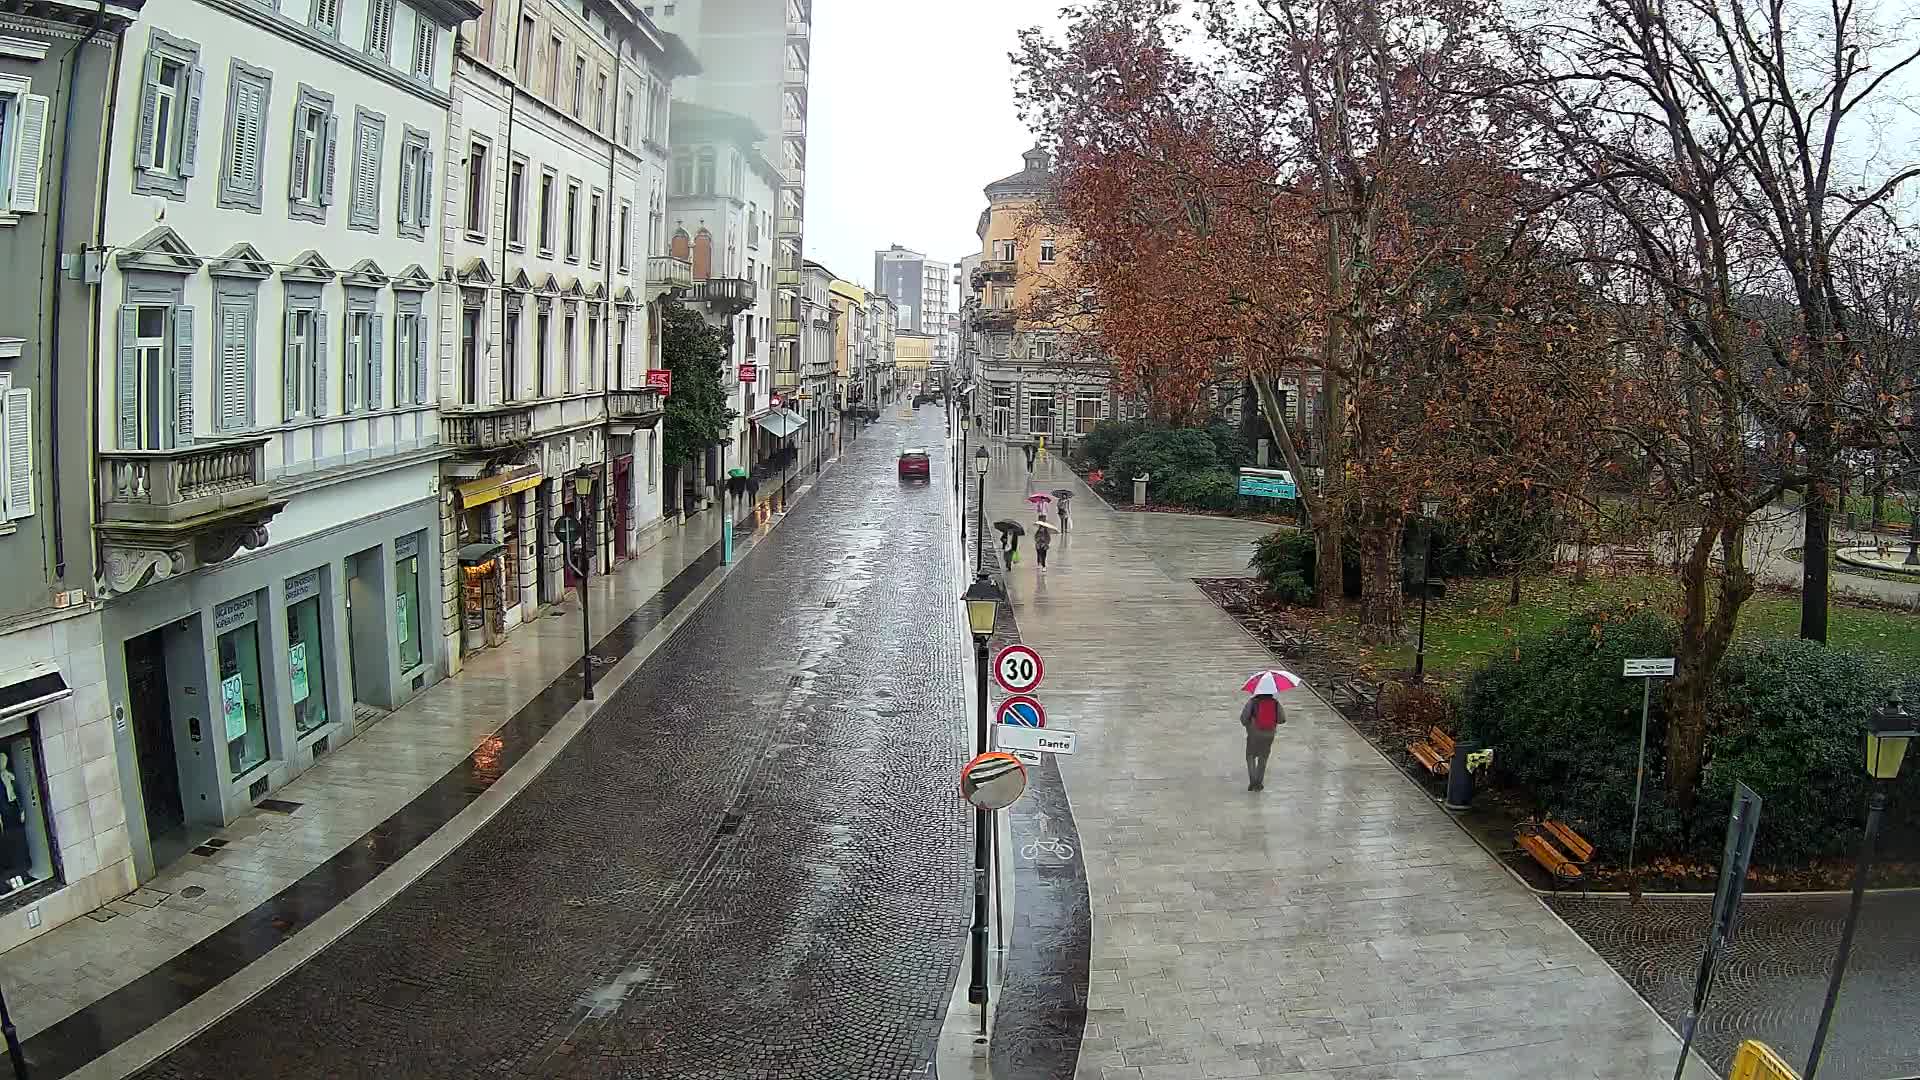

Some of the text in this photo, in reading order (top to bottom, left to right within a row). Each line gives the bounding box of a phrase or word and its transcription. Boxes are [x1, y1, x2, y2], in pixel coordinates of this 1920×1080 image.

[1006, 659, 1033, 680] 30
[223, 678, 240, 701] 130
[1039, 738, 1070, 749] Dante
